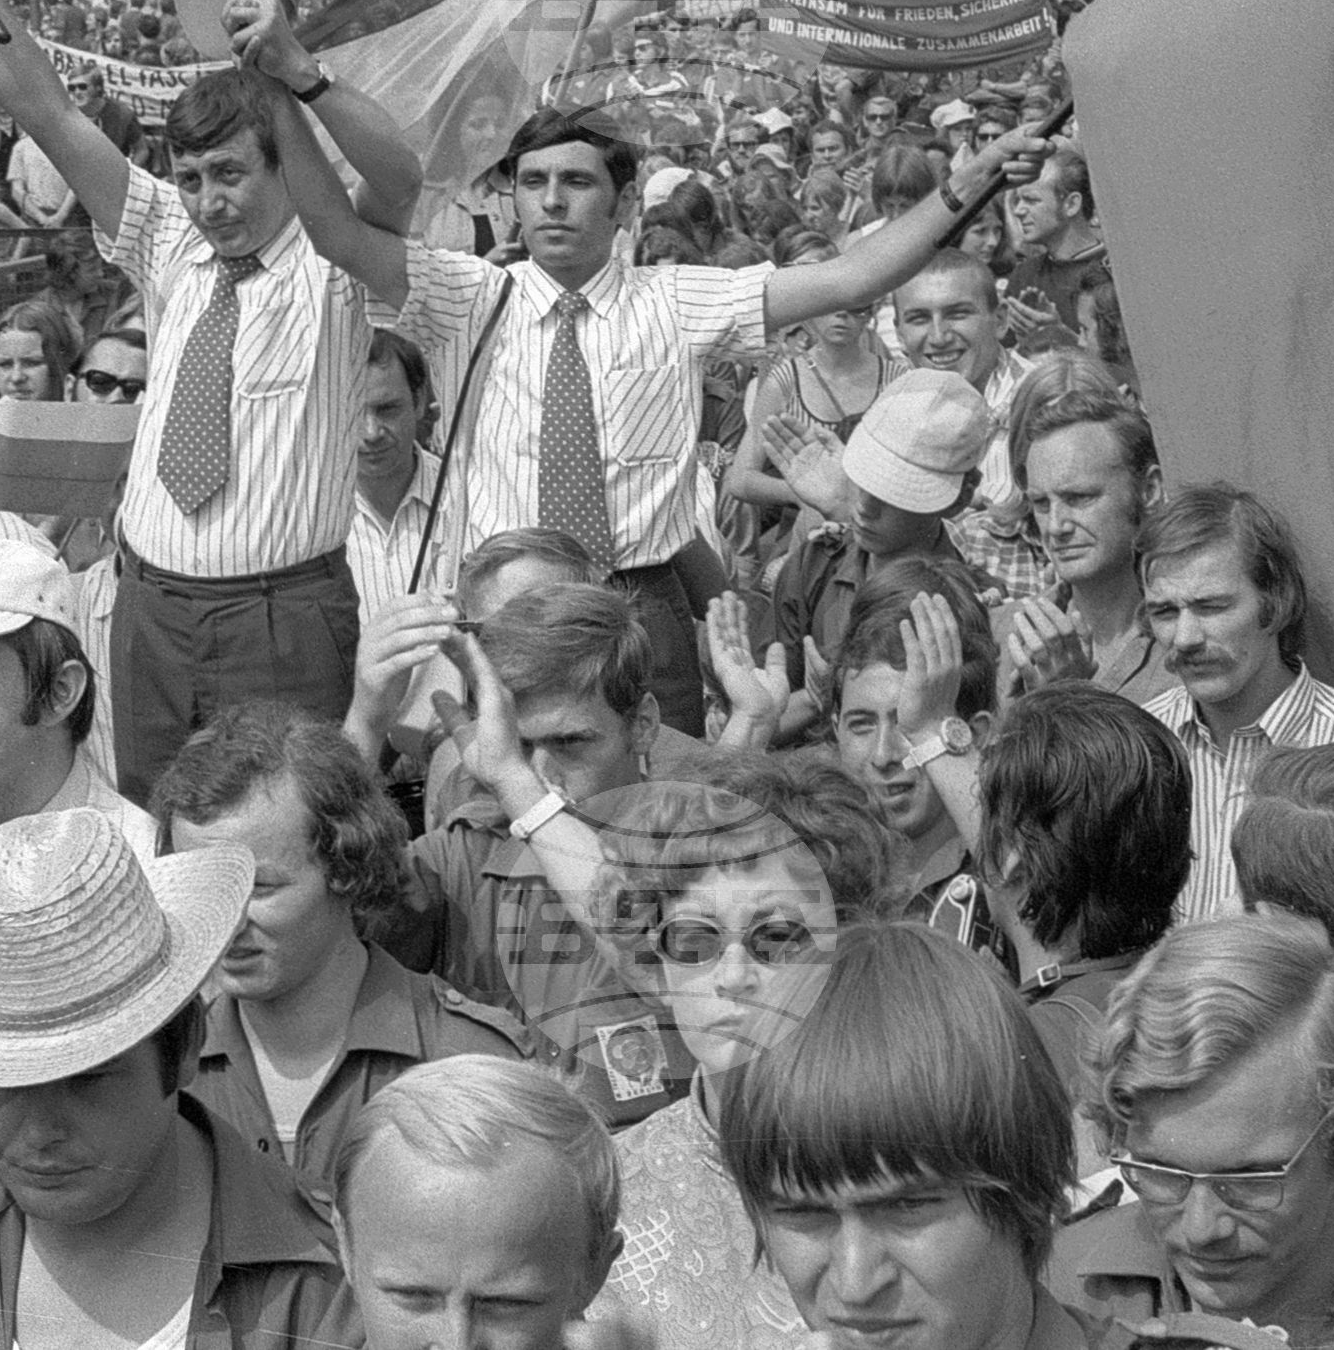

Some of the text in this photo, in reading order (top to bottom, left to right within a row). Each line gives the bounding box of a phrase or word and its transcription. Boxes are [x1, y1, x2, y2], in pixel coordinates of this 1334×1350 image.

[895, 6, 959, 22] FRIEDEN,
[768, 17, 794, 35] UND
[797, 23, 906, 50] INTERNATIONALE
